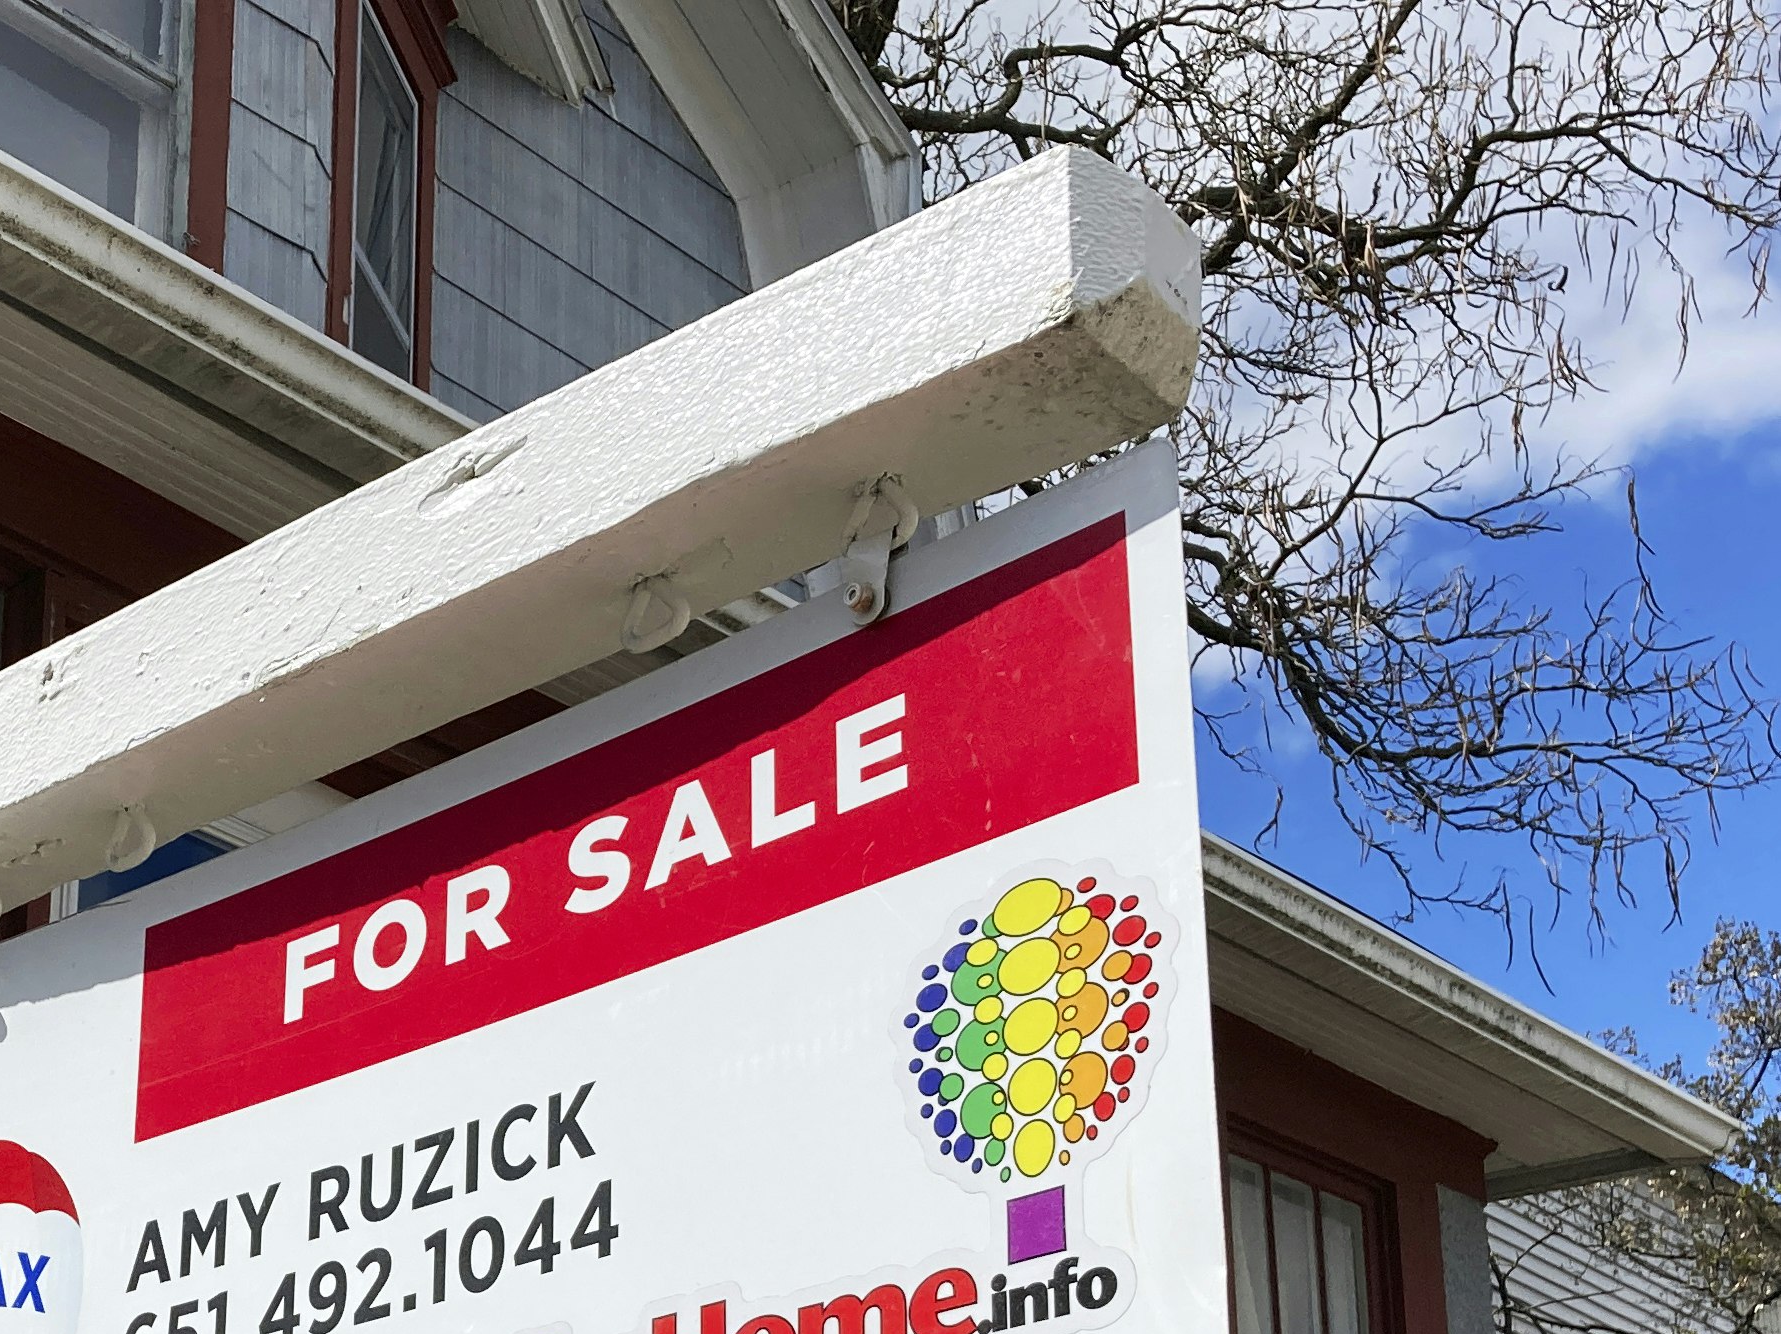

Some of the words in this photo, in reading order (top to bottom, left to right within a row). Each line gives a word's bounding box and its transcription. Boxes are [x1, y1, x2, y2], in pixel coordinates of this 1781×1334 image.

[283, 864, 510, 1025] FOR
[563, 693, 910, 915] SALE
[125, 1181, 281, 1293] AMY
[308, 1080, 597, 1241] RUZICK
